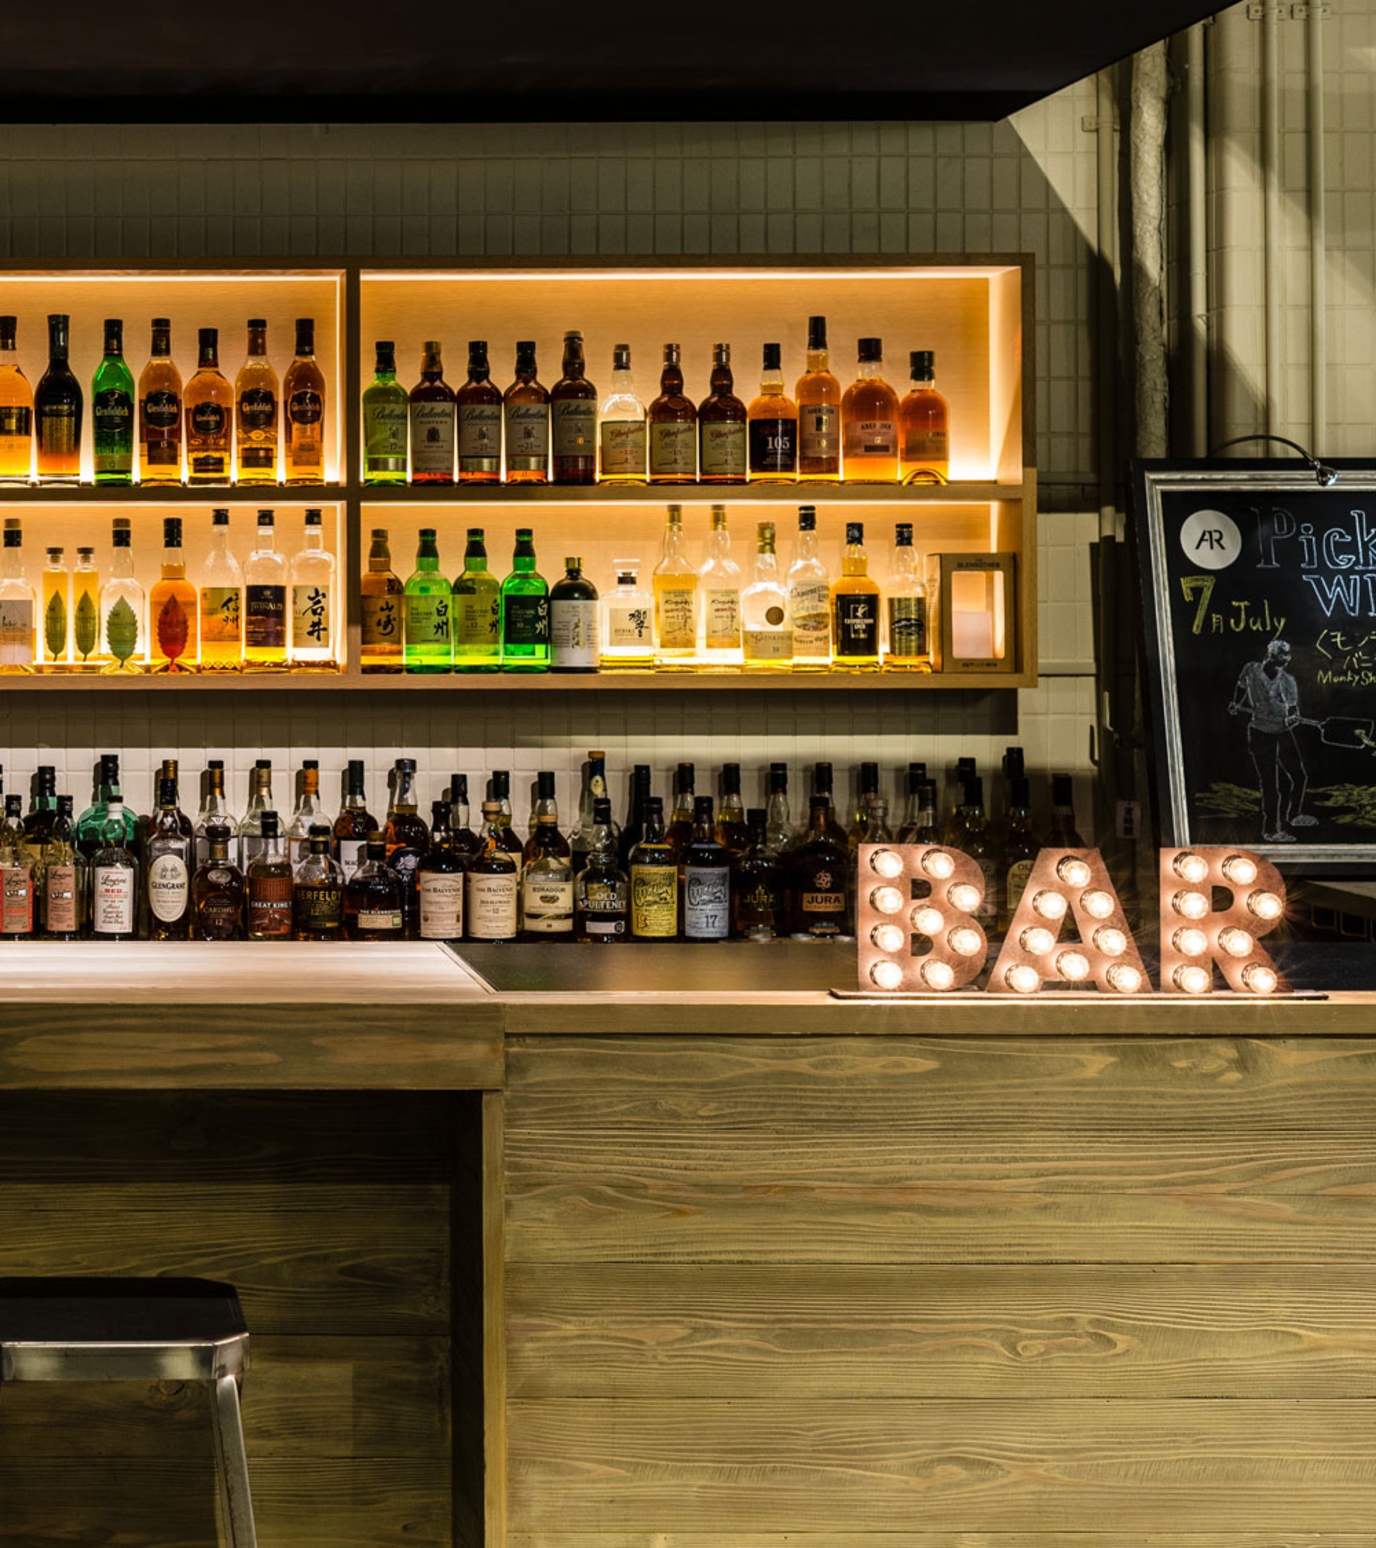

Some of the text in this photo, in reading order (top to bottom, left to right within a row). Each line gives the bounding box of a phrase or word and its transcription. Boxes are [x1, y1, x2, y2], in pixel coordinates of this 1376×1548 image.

[96, 405, 129, 417] Glenfiddich
[146, 402, 178, 413] Glenfiddich
[242, 401, 273, 412] Glenfiddich
[196, 413, 220, 421] Glenfiddich
[860, 422, 892, 430] ABEROUR
[766, 436, 791, 450] 105
[1195, 529, 1226, 551] AR
[221, 592, 240, 630] 信州
[301, 587, 328, 642] 岩井
[375, 600, 397, 637] 山崎
[433, 599, 450, 640] 白州
[534, 599, 549, 639] 白州
[1230, 599, 1287, 641] July
[101, 874, 127, 888] Longrow
[297, 890, 342, 901] BERFELDY
[433, 886, 461, 894] BALVENIE
[487, 886, 514, 894] BALVENIE
[595, 892, 618, 901] OLD
[806, 895, 842, 905] JURA
[203, 906, 235, 914] CARDHU
[582, 900, 627, 909] PULTENEY
[215, 918, 224, 926] 12
[704, 914, 718, 929] 17
[858, 843, 1293, 994] BAR
